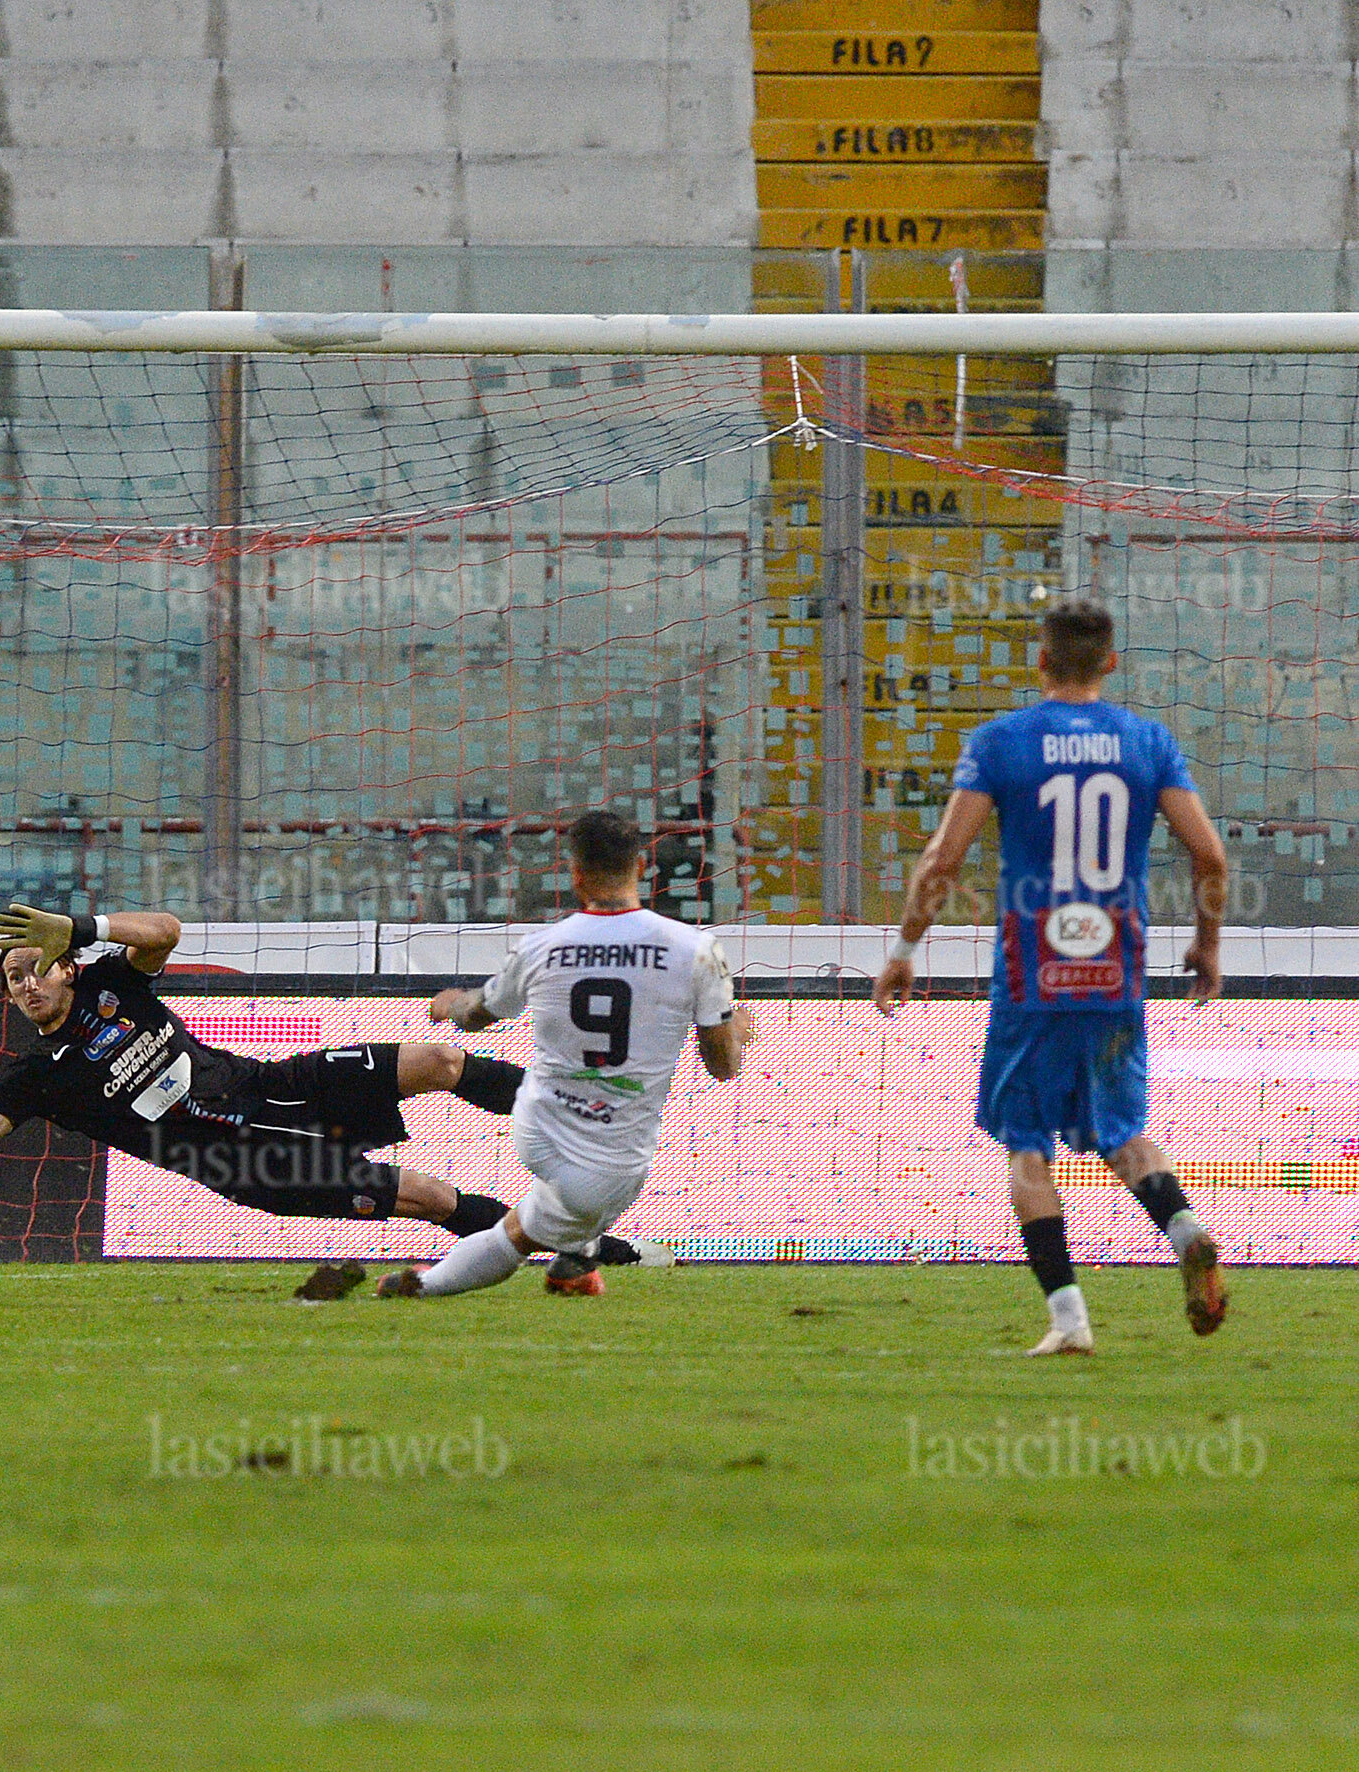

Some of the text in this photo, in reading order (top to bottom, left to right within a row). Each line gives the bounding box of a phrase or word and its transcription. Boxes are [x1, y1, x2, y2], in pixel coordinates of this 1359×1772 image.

[1043, 733, 1121, 764] BIONDI
[1038, 772, 1130, 893] 10
[546, 943, 669, 971] FERRANTE
[570, 977, 633, 1068] 9
